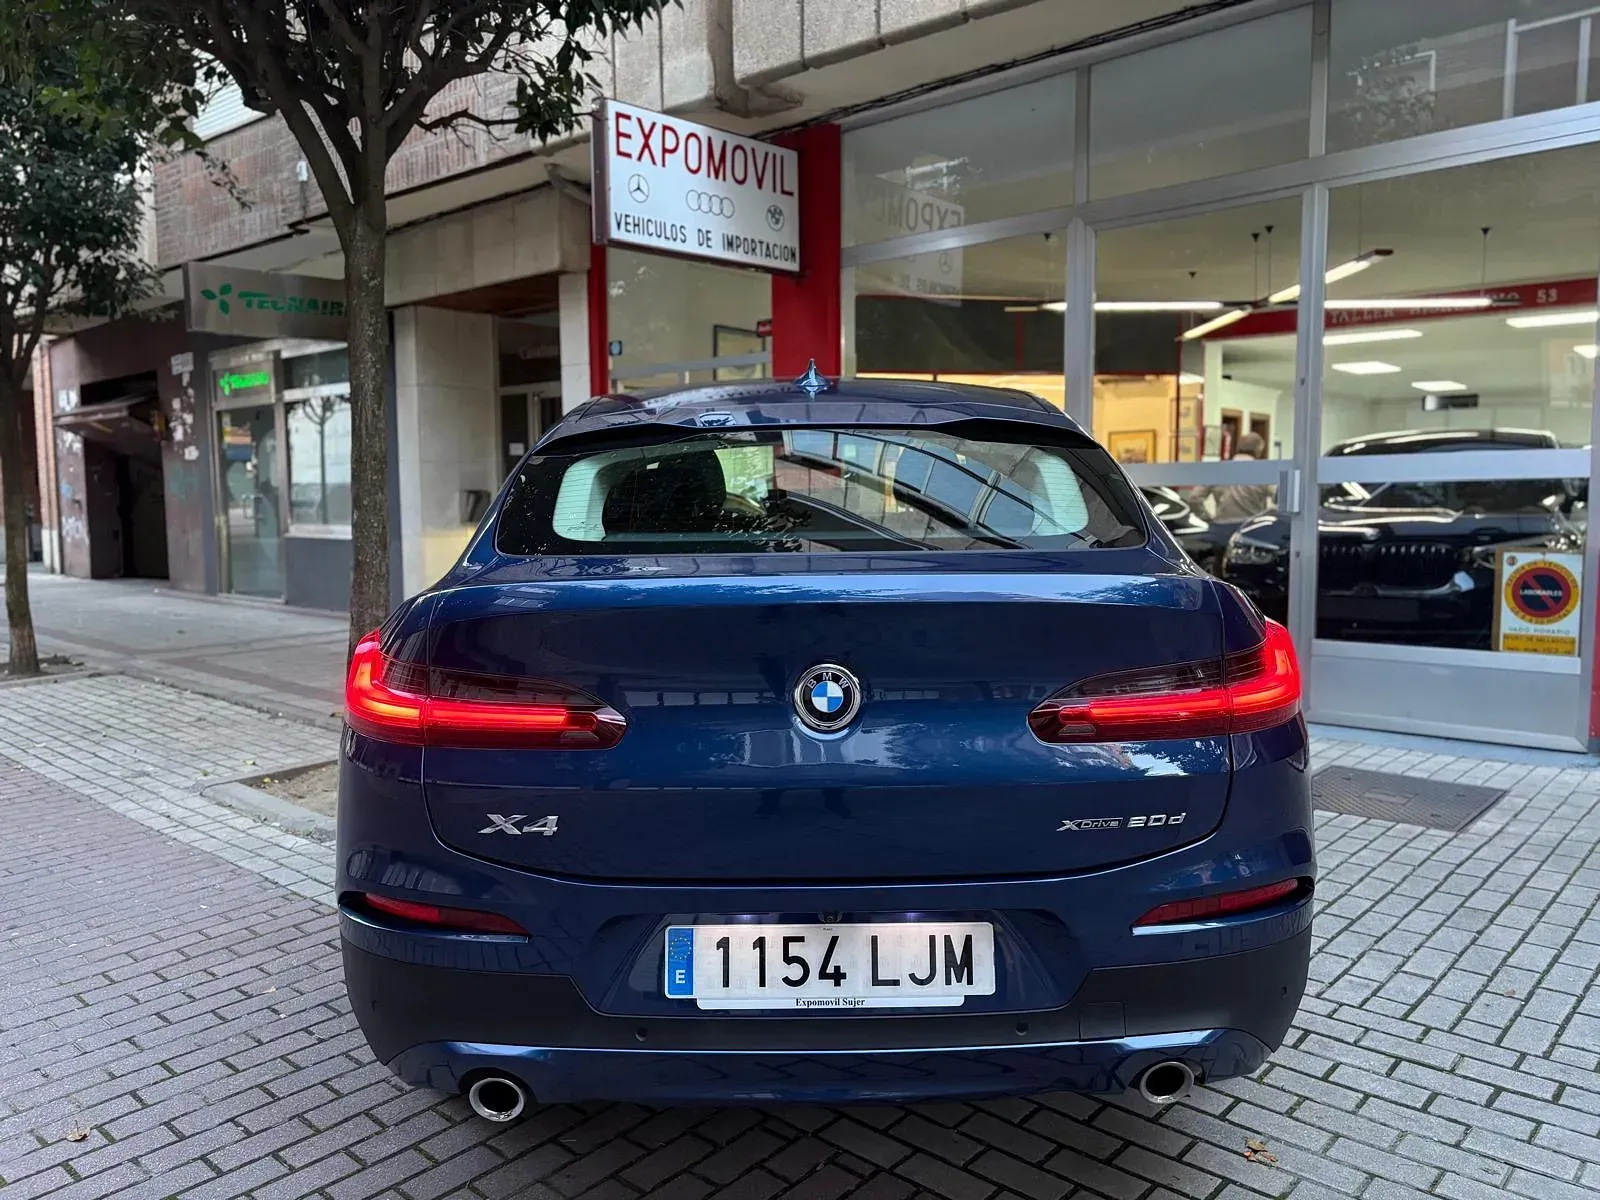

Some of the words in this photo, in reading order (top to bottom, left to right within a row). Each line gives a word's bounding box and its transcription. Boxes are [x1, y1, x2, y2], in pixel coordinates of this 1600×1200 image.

[614, 112, 795, 197] EXPOMOVIL
[614, 212, 687, 244] VEHICULOS
[697, 229, 713, 249] DE
[722, 233, 796, 264] IMPORTACION
[1536, 288, 1558, 303] 53
[807, 672, 850, 688] BMW
[477, 814, 559, 836] X4
[1127, 812, 1186, 828] 20d
[716, 934, 847, 988] 1154
[870, 933, 974, 987] LJM
[675, 969, 686, 984] E
[795, 997, 840, 1007] Expomovil
[842, 997, 866, 1008] Sujer
